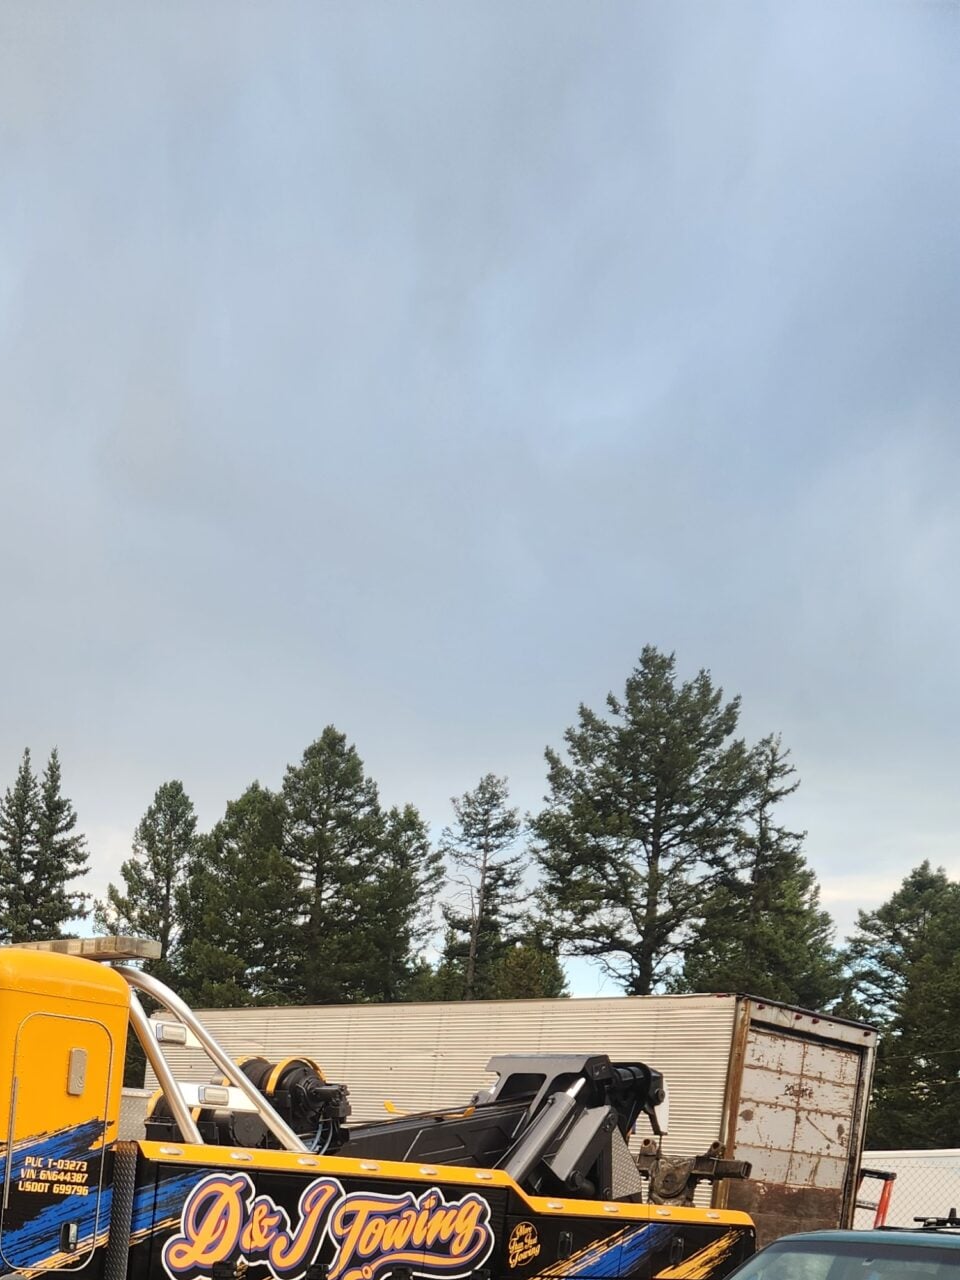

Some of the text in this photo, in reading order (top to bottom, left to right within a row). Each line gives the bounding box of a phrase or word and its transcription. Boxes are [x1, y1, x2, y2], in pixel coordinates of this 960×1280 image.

[25, 1156, 88, 1172] PUC T-03273
[20, 1168, 37, 1179] VIN
[18, 1181, 89, 1196] USDOT 699796
[327, 1194, 487, 1280] Towing
